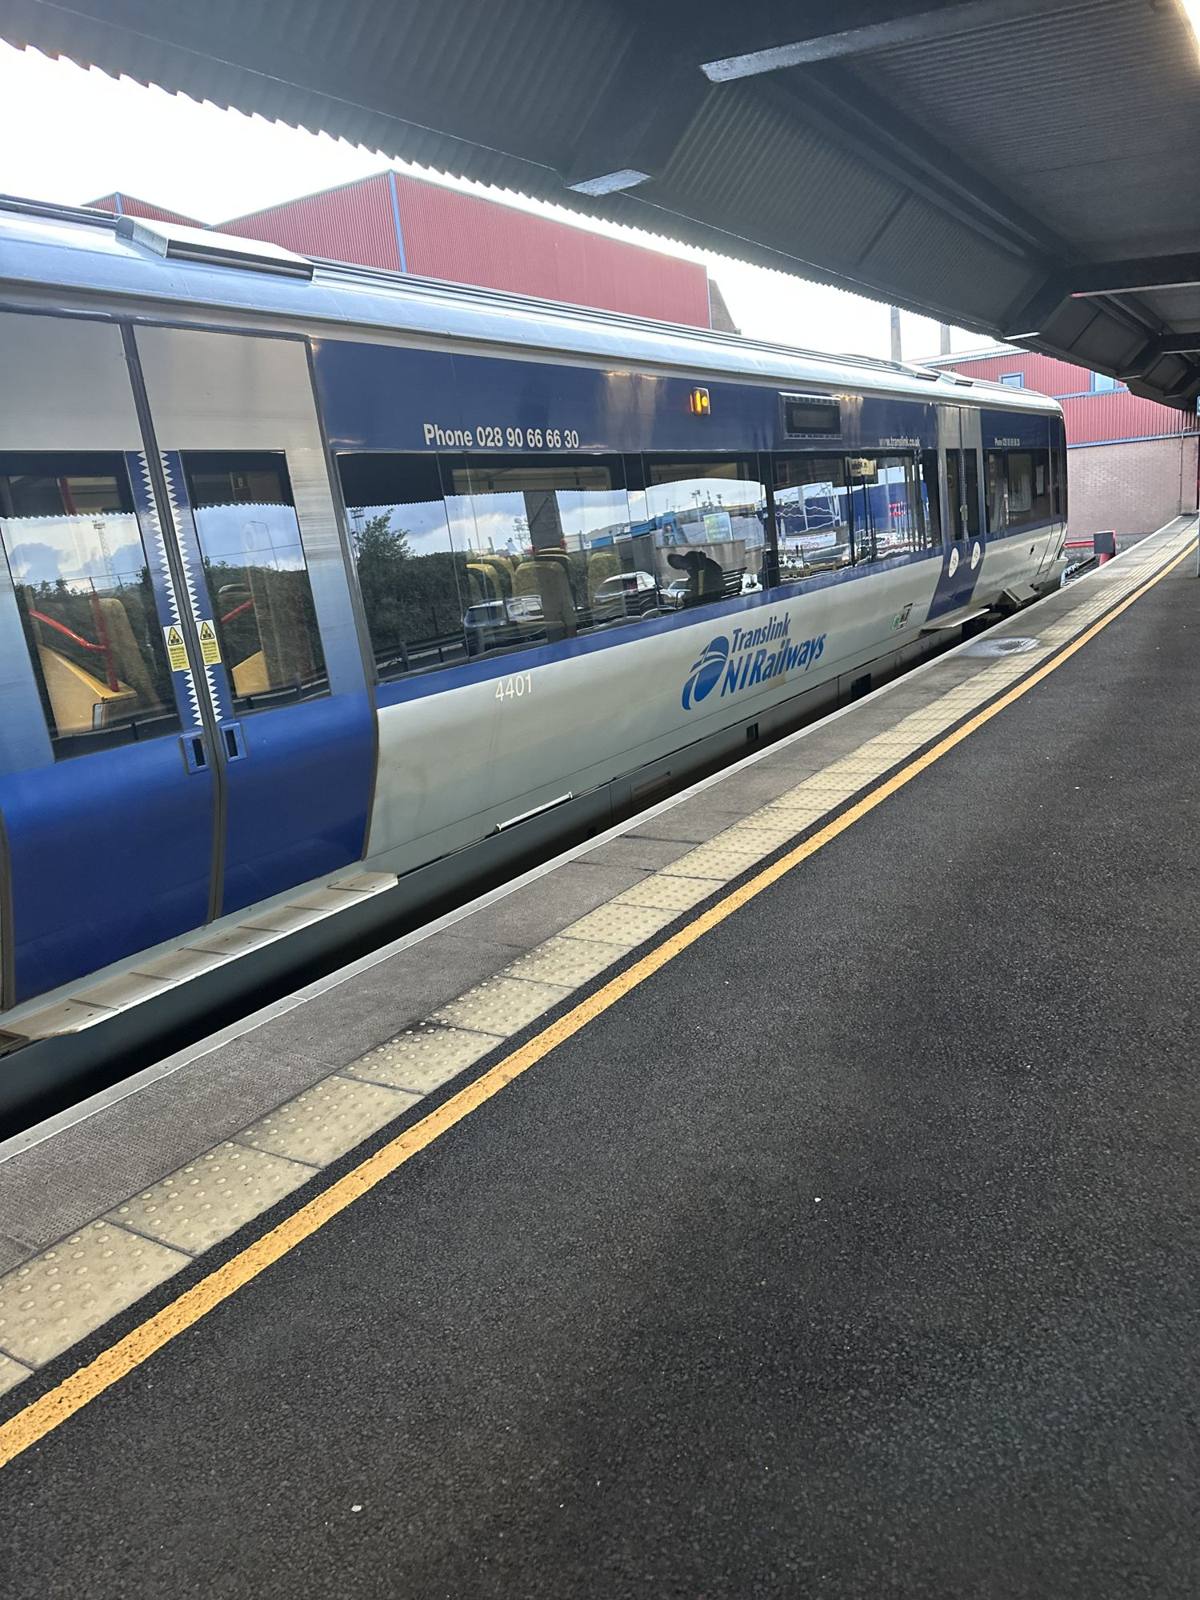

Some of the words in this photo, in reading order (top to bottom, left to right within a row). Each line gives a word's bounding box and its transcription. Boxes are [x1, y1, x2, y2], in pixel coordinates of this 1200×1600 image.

[423, 423, 473, 446] Phone
[476, 426, 504, 447] 028
[506, 427, 524, 447] 90
[527, 428, 543, 448] 66
[545, 429, 562, 448] 66
[564, 430, 580, 448] 30
[732, 612, 791, 653] Translink
[495, 672, 532, 702] 4401
